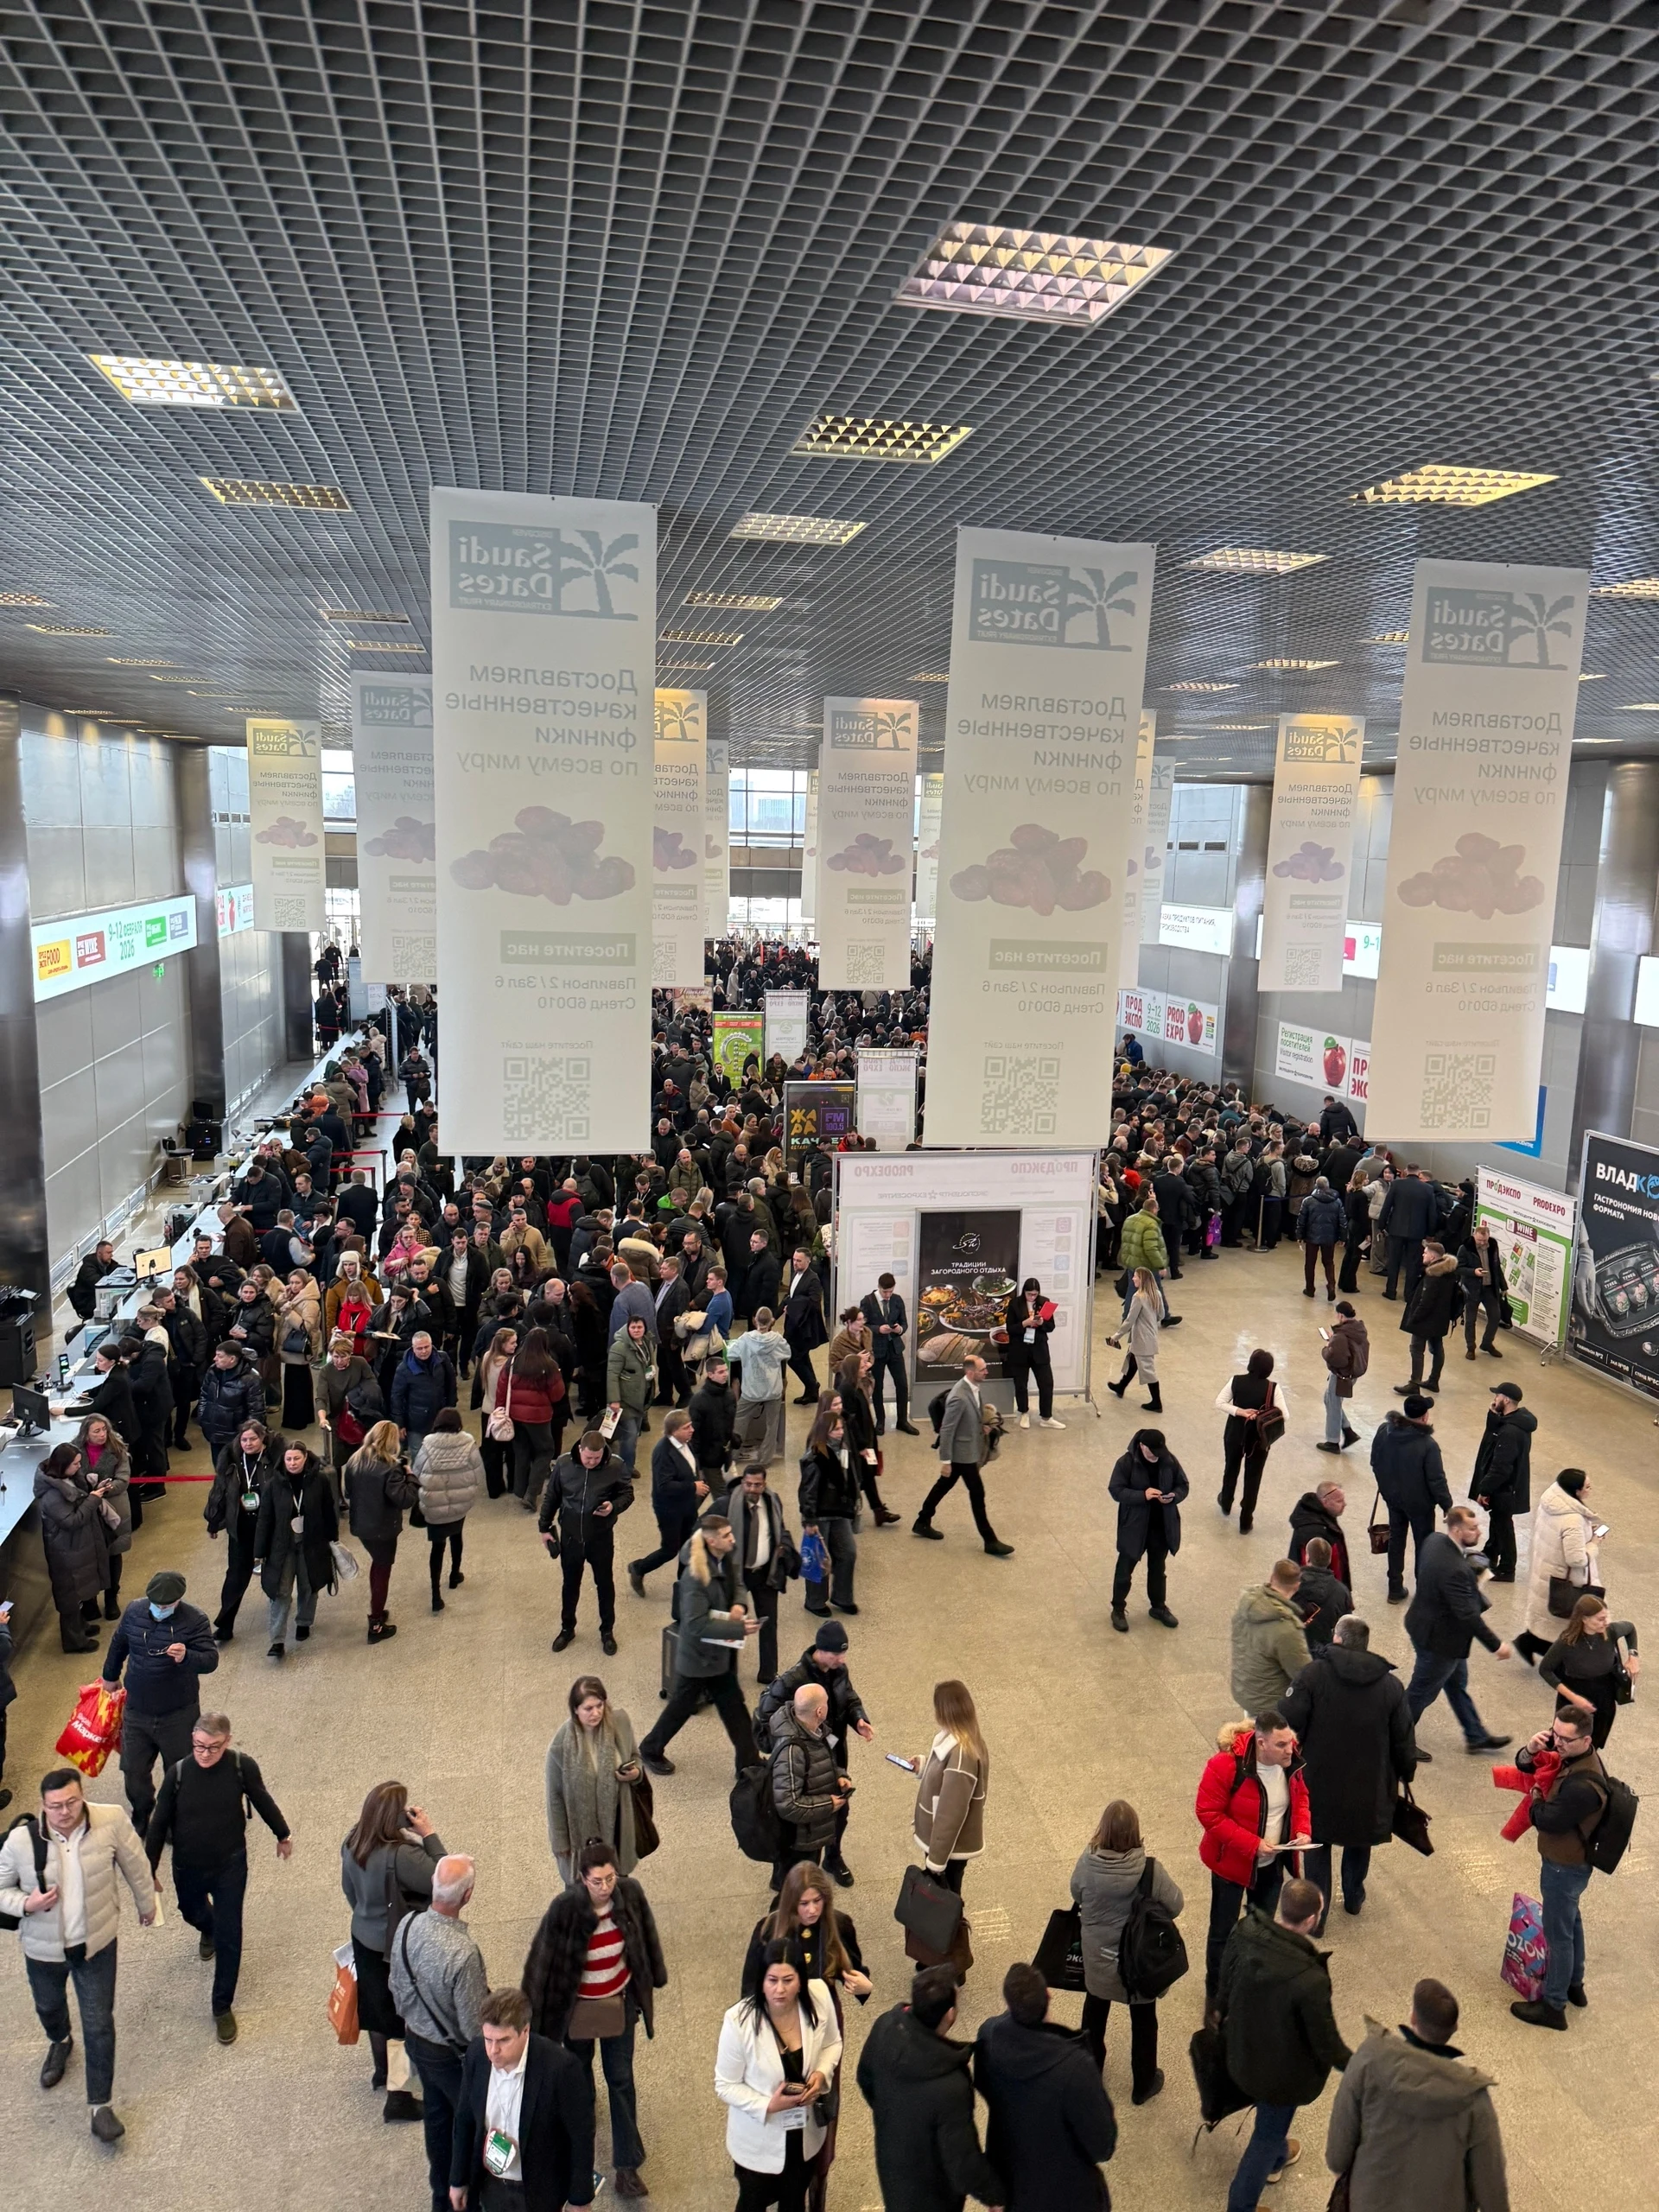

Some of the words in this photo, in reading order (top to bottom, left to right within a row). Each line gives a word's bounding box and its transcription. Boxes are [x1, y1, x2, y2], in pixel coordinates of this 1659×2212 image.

[120, 938, 135, 960] 2026
[1363, 935, 1380, 950] 9-1
[1126, 995, 1142, 1015] ПРОД
[1125, 1011, 1142, 1028] ЭКСПО
[1166, 1006, 1185, 1025] PROD
[1147, 1020, 1160, 1034] 2026
[1166, 1023, 1185, 1042] EXPO
[1353, 1057, 1370, 1077] ПР
[1351, 1077, 1369, 1099] ЭКС
[825, 1112, 844, 1122] FM
[1486, 1179, 1521, 1200] ПРОДЭКСПО
[1533, 1197, 1566, 1217] PRODEXPO
[1592, 1204, 1624, 1221] ФОРМАТА
[1594, 1192, 1642, 1216] ГАСТРОНОМИЯ
[1643, 1210, 1659, 1222] НОВ
[1516, 1222, 1534, 1236] WINE
[1507, 1929, 1546, 1961] OZON
